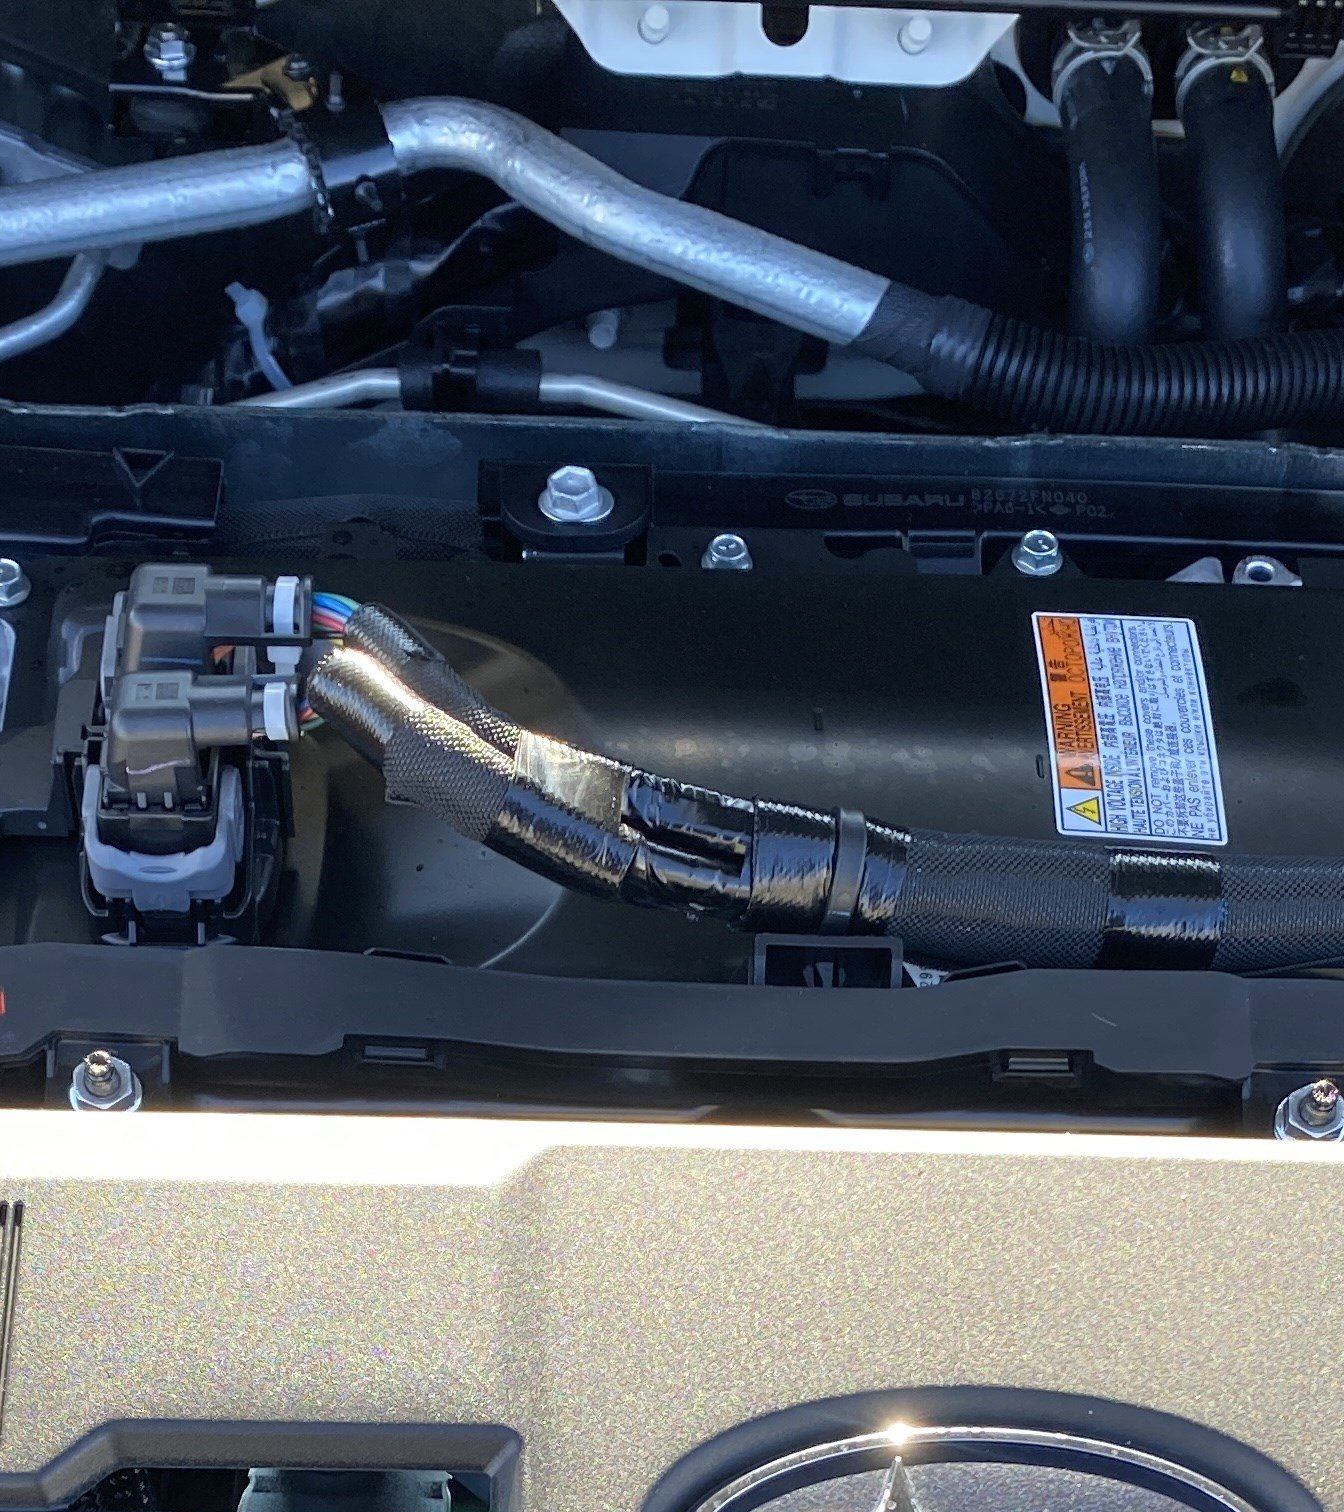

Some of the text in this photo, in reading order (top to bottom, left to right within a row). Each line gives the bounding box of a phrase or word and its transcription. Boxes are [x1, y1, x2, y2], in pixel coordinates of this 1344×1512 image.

[844, 493, 964, 507] SUBARU
[1137, 697, 1151, 724] covers
[1170, 687, 1191, 733] couvercles
[1142, 728, 1155, 751] these
[1180, 733, 1195, 754] ces
[1147, 756, 1160, 788] remove
[1183, 759, 1201, 792] enlever
[1105, 779, 1127, 811] VOLTAGE
[1126, 778, 1145, 808] TENSION
[1150, 793, 1163, 813] NOT
[1187, 797, 1203, 816] PAS
[1110, 813, 1130, 832] HIGH
[1130, 808, 1148, 833] HAUTE
[1153, 819, 1166, 834] DO
[1190, 818, 1207, 838] NE
